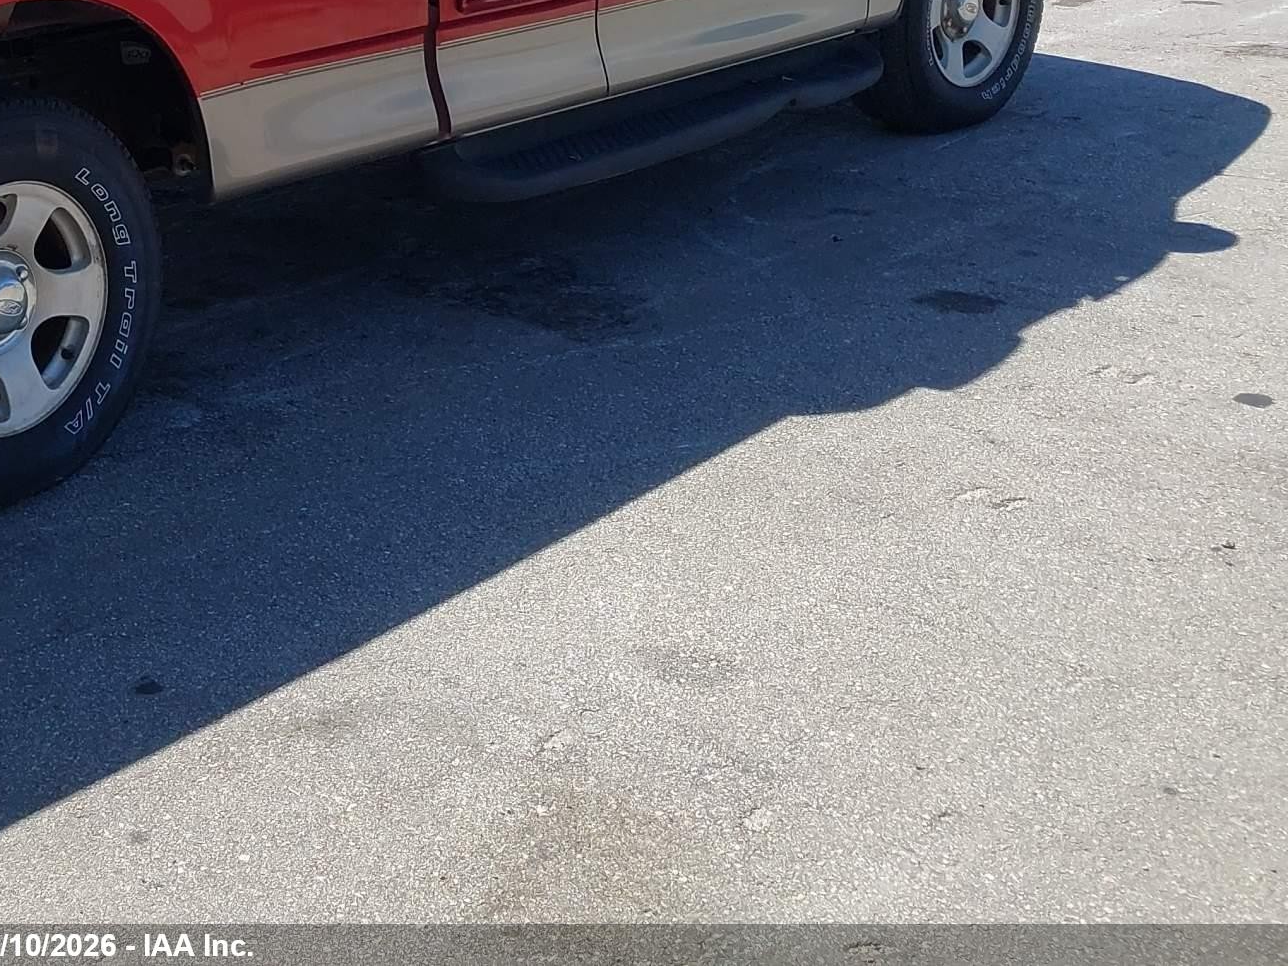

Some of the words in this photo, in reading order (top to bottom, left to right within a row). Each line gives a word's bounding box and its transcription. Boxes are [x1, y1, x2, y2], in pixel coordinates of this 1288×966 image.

[74, 167, 131, 246] Long
[109, 260, 138, 369] Trail
[63, 382, 111, 434] T/A
